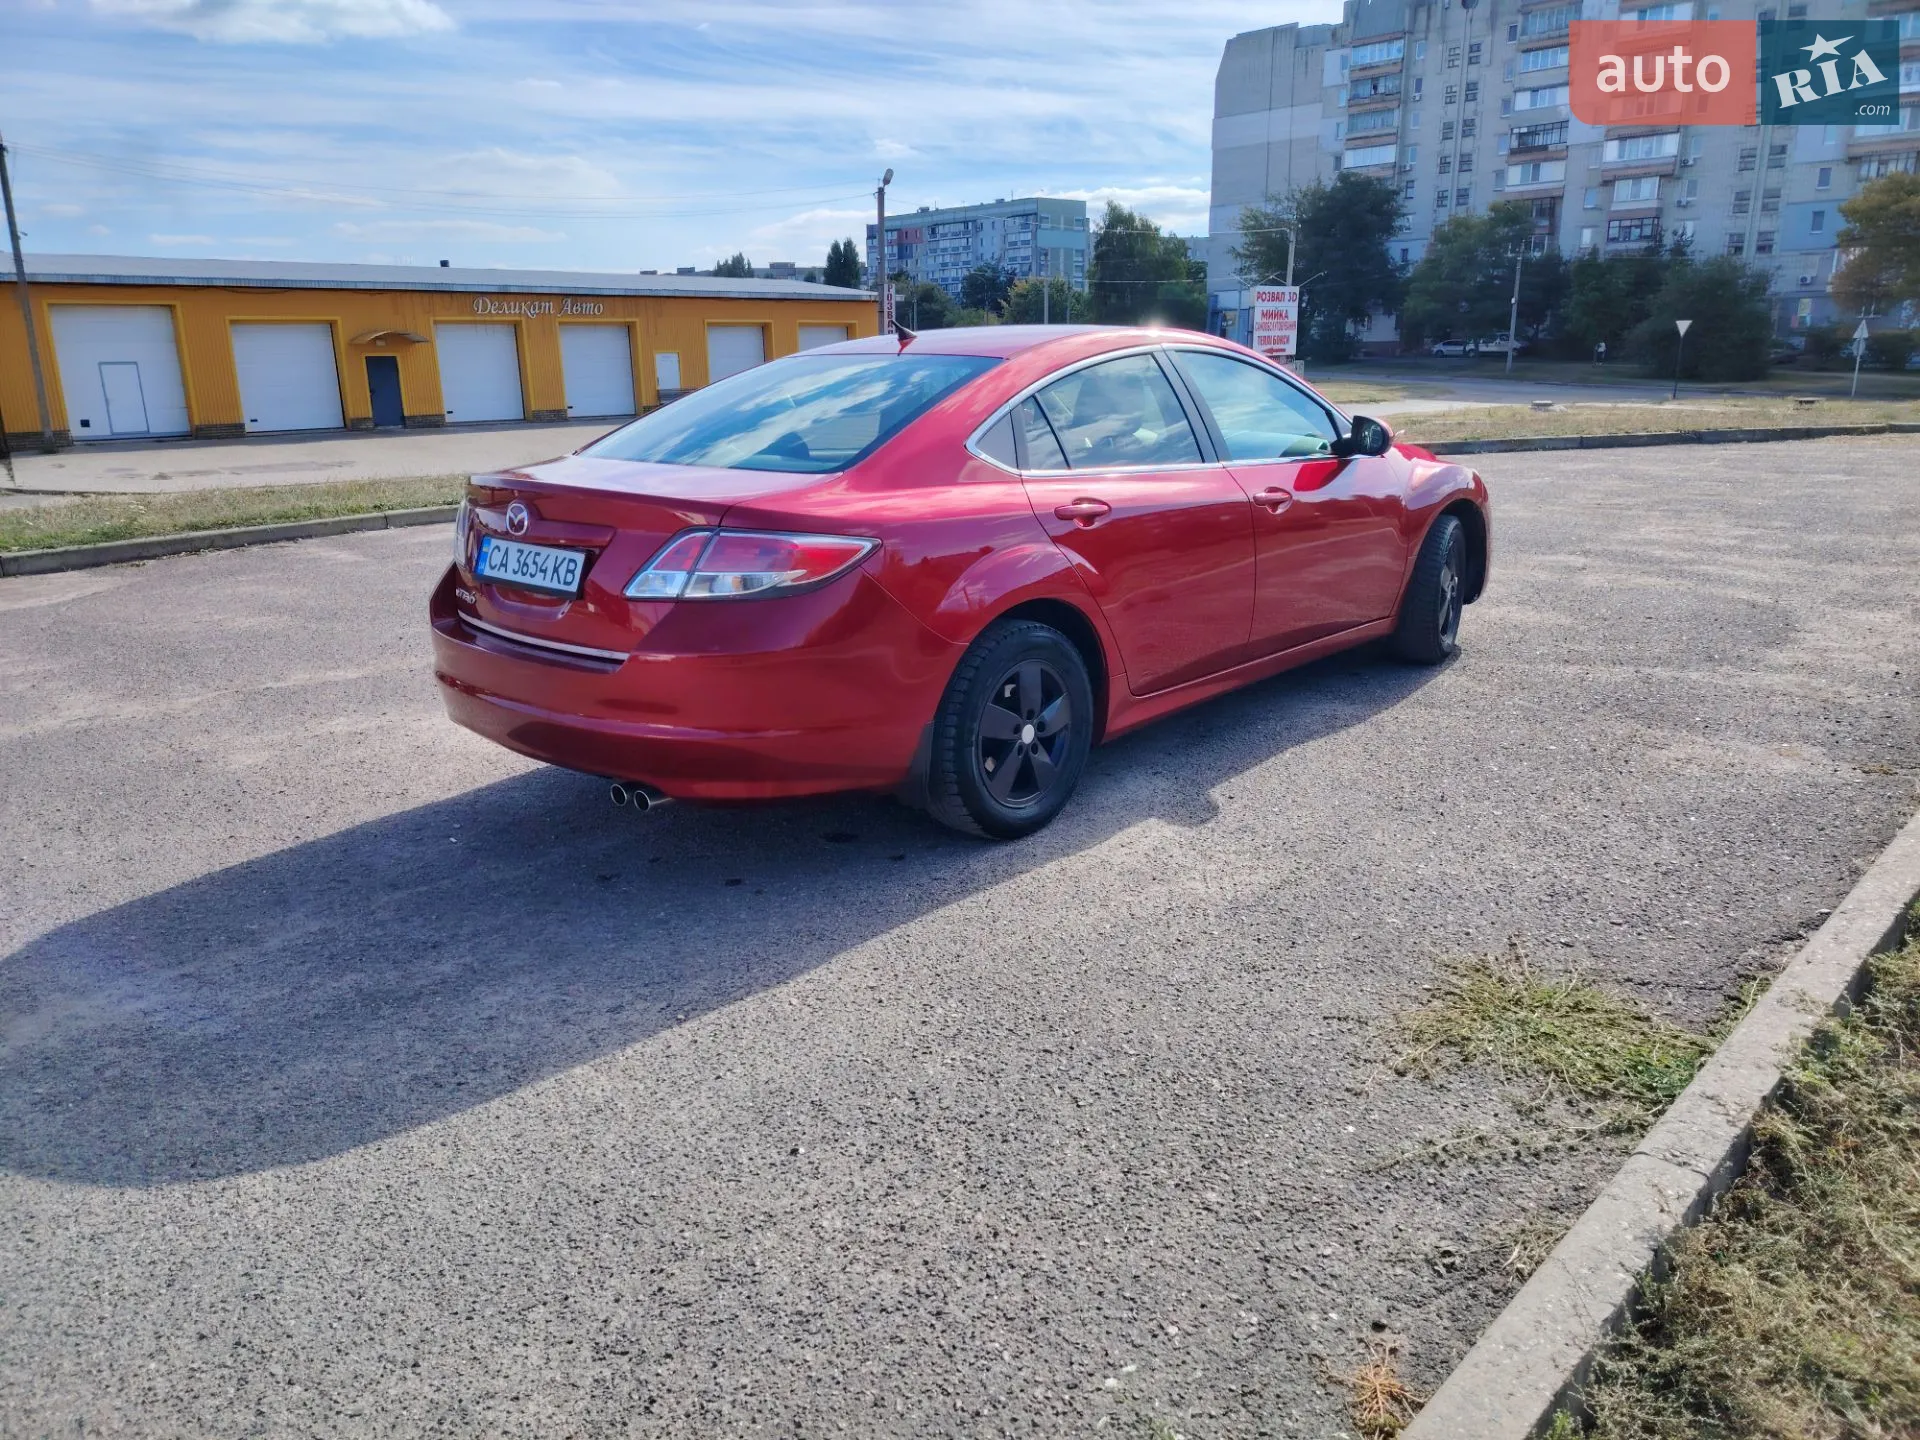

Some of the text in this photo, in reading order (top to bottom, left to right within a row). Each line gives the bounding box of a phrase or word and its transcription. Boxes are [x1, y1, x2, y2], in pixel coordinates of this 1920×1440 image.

[1256, 291, 1286, 302] РОЗВАЛ
[473, 297, 604, 318] Деликат Авто
[488, 545, 578, 586] CA 3654 KB
